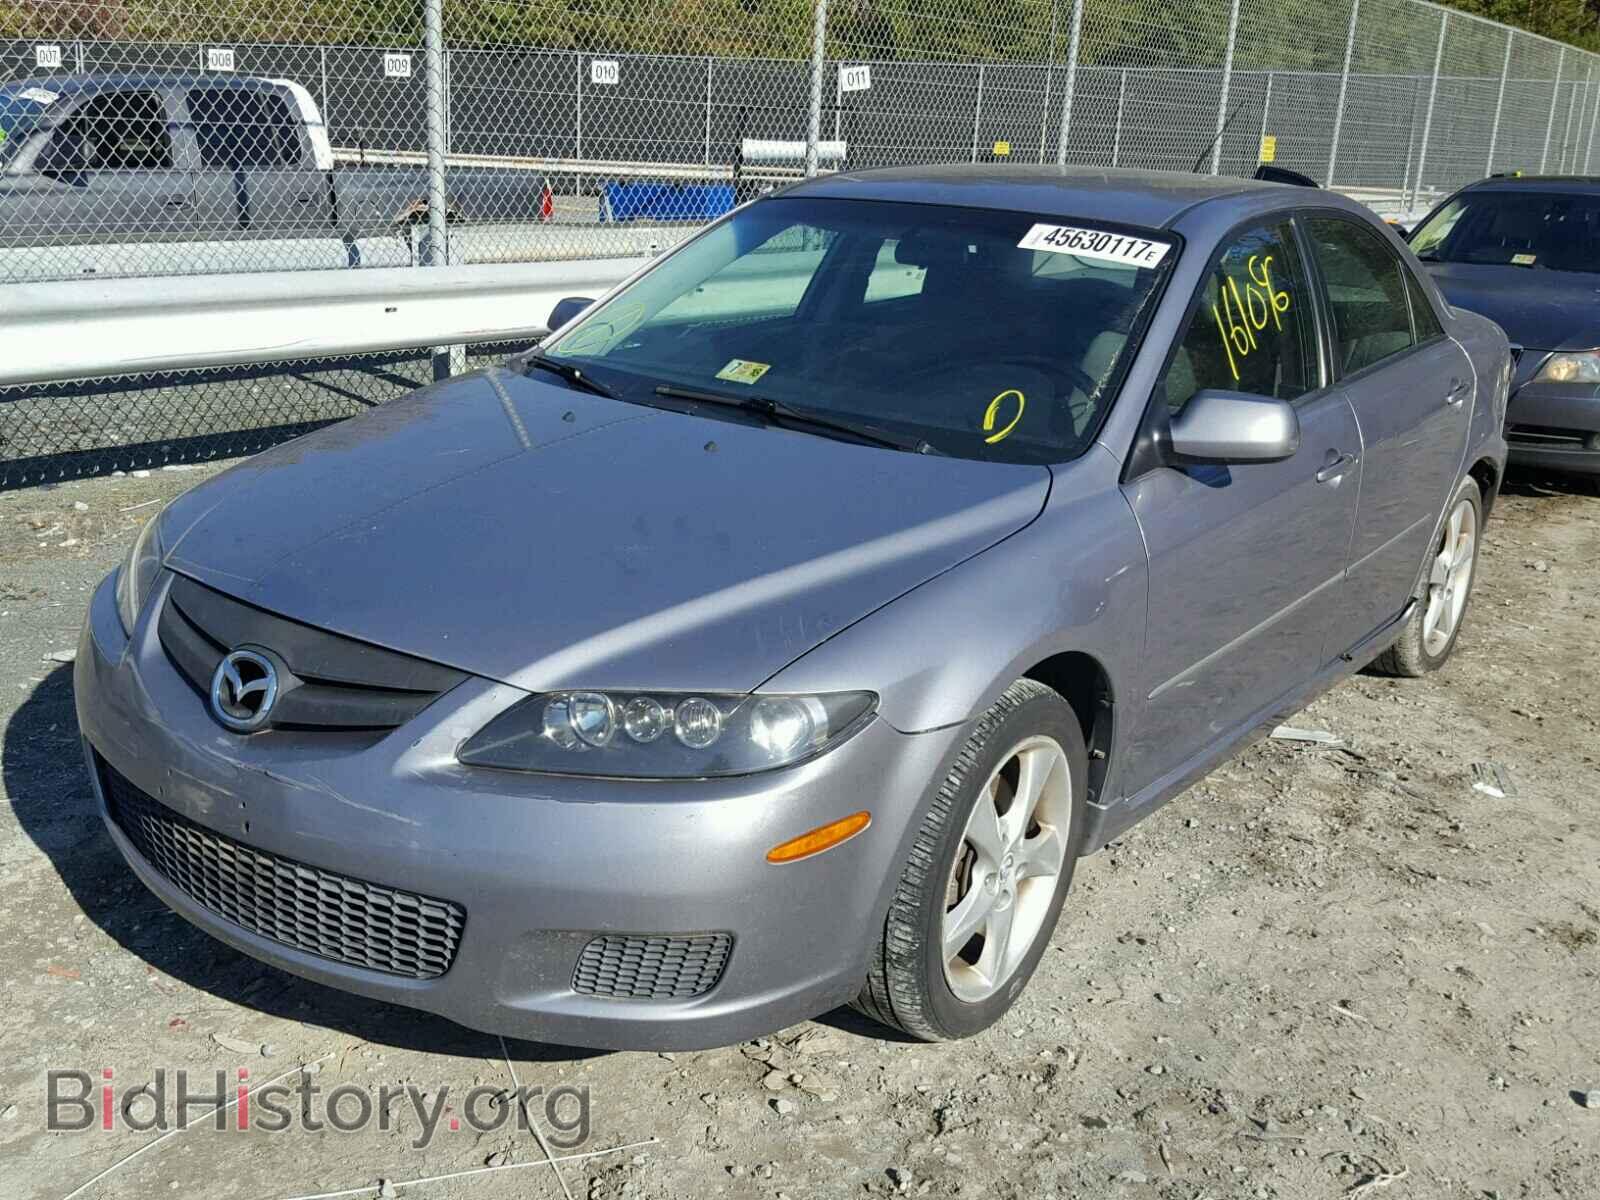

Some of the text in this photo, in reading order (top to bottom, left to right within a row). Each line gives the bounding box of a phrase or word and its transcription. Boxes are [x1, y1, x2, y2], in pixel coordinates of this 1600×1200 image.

[39, 49, 57, 63] 007
[211, 52, 233, 67] 008
[387, 58, 408, 73] 009
[595, 64, 616, 80] 010
[847, 70, 866, 88] 011
